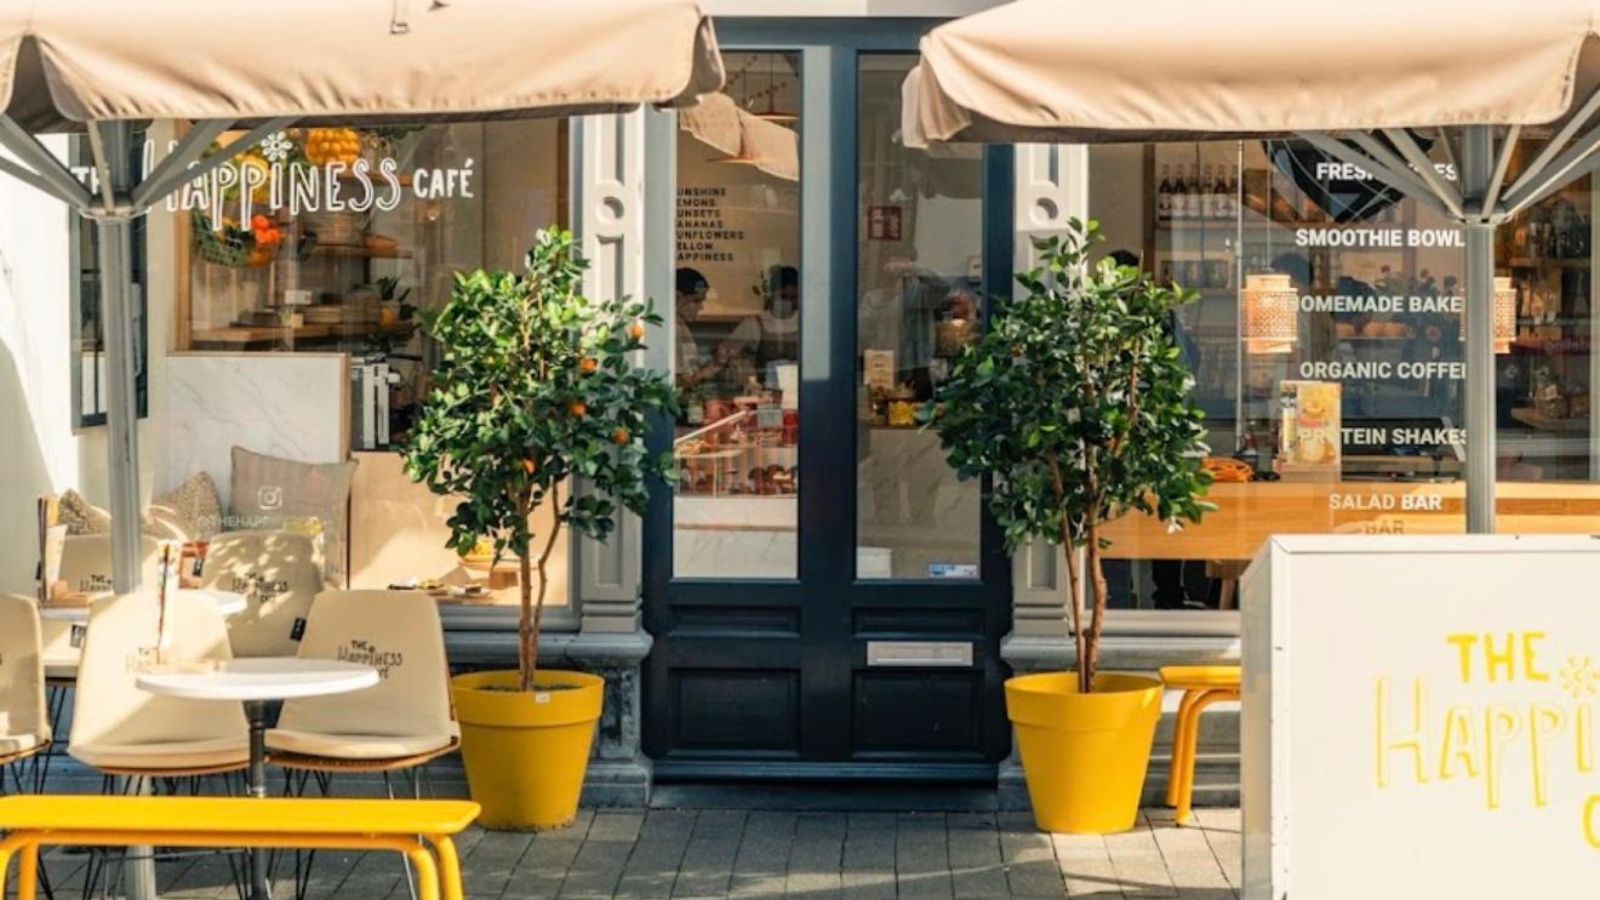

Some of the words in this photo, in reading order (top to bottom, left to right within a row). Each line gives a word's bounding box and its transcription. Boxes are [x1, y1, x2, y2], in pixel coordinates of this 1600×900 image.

[413, 158, 474, 199] CAFÉ
[1316, 162, 1373, 181] FRES
[677, 187, 726, 196] UNSHINE
[676, 198, 716, 207] EMONS
[677, 209, 720, 218] UNSETS
[677, 220, 723, 229] ANANAS
[677, 231, 744, 240] UNFLOWERS
[1295, 228, 1403, 247] SMOOTHIE
[1407, 229, 1466, 247] BOWL
[677, 242, 713, 250] ELLOW
[678, 252, 733, 261] APPINESS
[1408, 295, 1464, 312] BAKE
[1300, 361, 1392, 379] ORGANIC
[1301, 428, 1386, 446] PRTEIN
[1328, 493, 1396, 510] SALAD
[1401, 494, 1442, 510] BAR
[1446, 631, 1551, 683] THE
[1374, 676, 1593, 810] HAPPI
